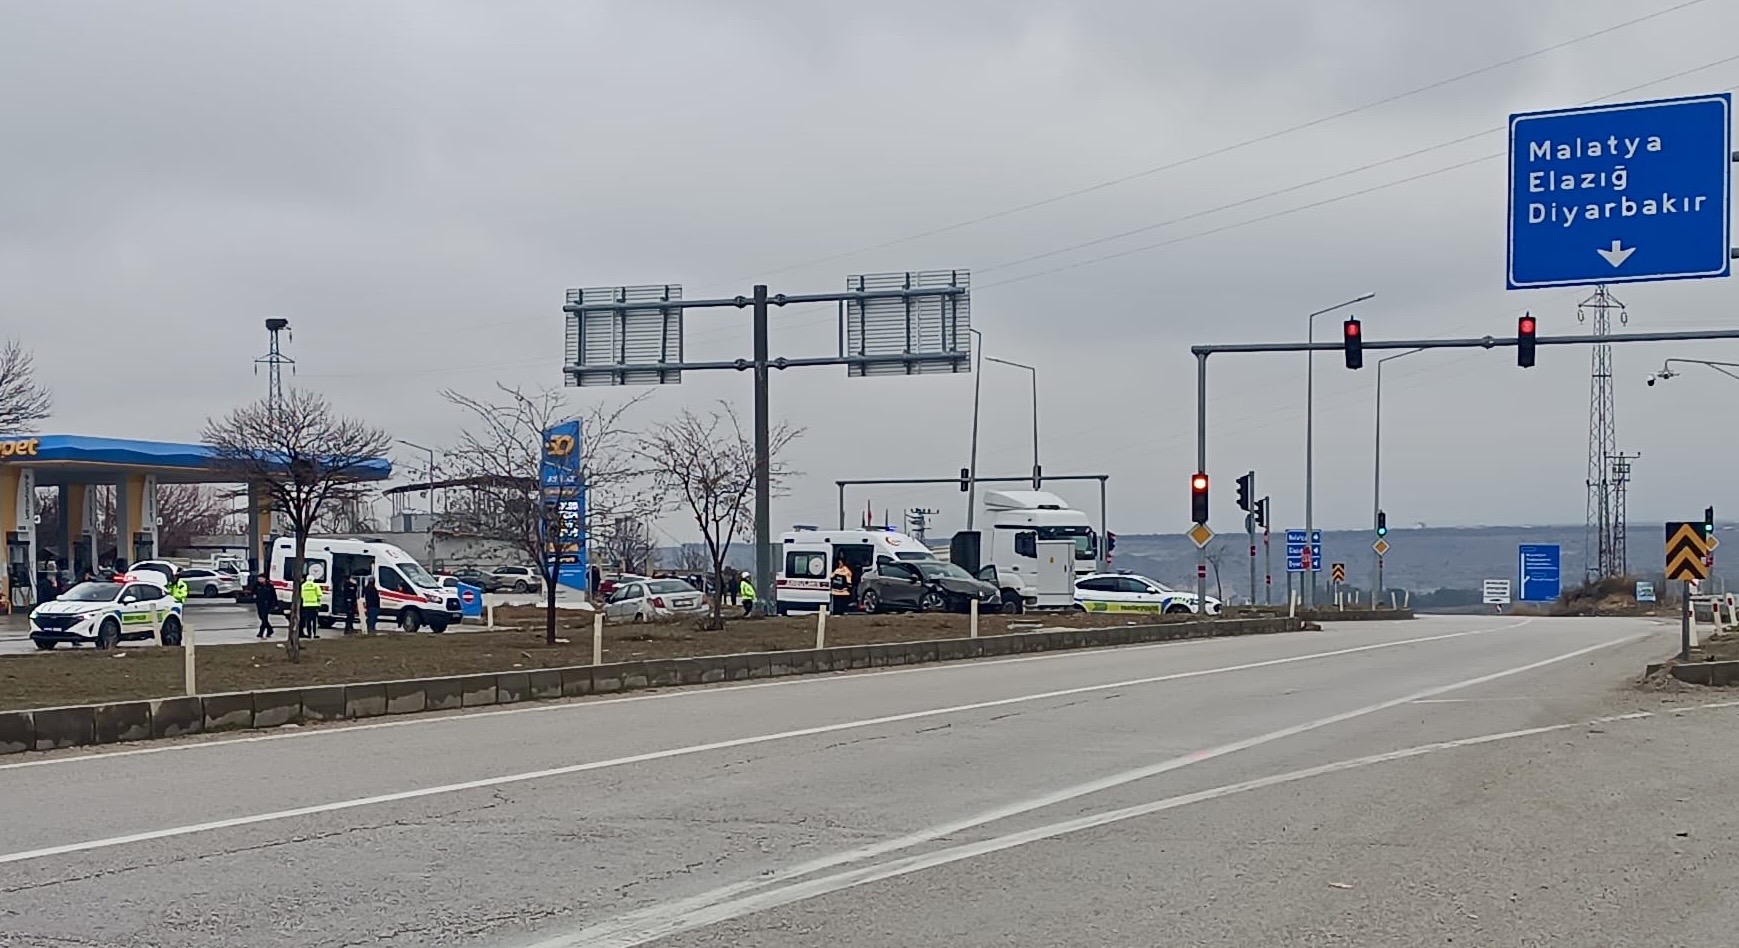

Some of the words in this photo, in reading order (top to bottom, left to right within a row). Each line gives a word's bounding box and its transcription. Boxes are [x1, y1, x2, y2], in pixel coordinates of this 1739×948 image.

[1529, 135, 1661, 161] Malatya
[1529, 165, 1628, 193] Elazığ
[1528, 192, 1707, 228] Diyarbakır
[0, 437, 39, 457] pet
